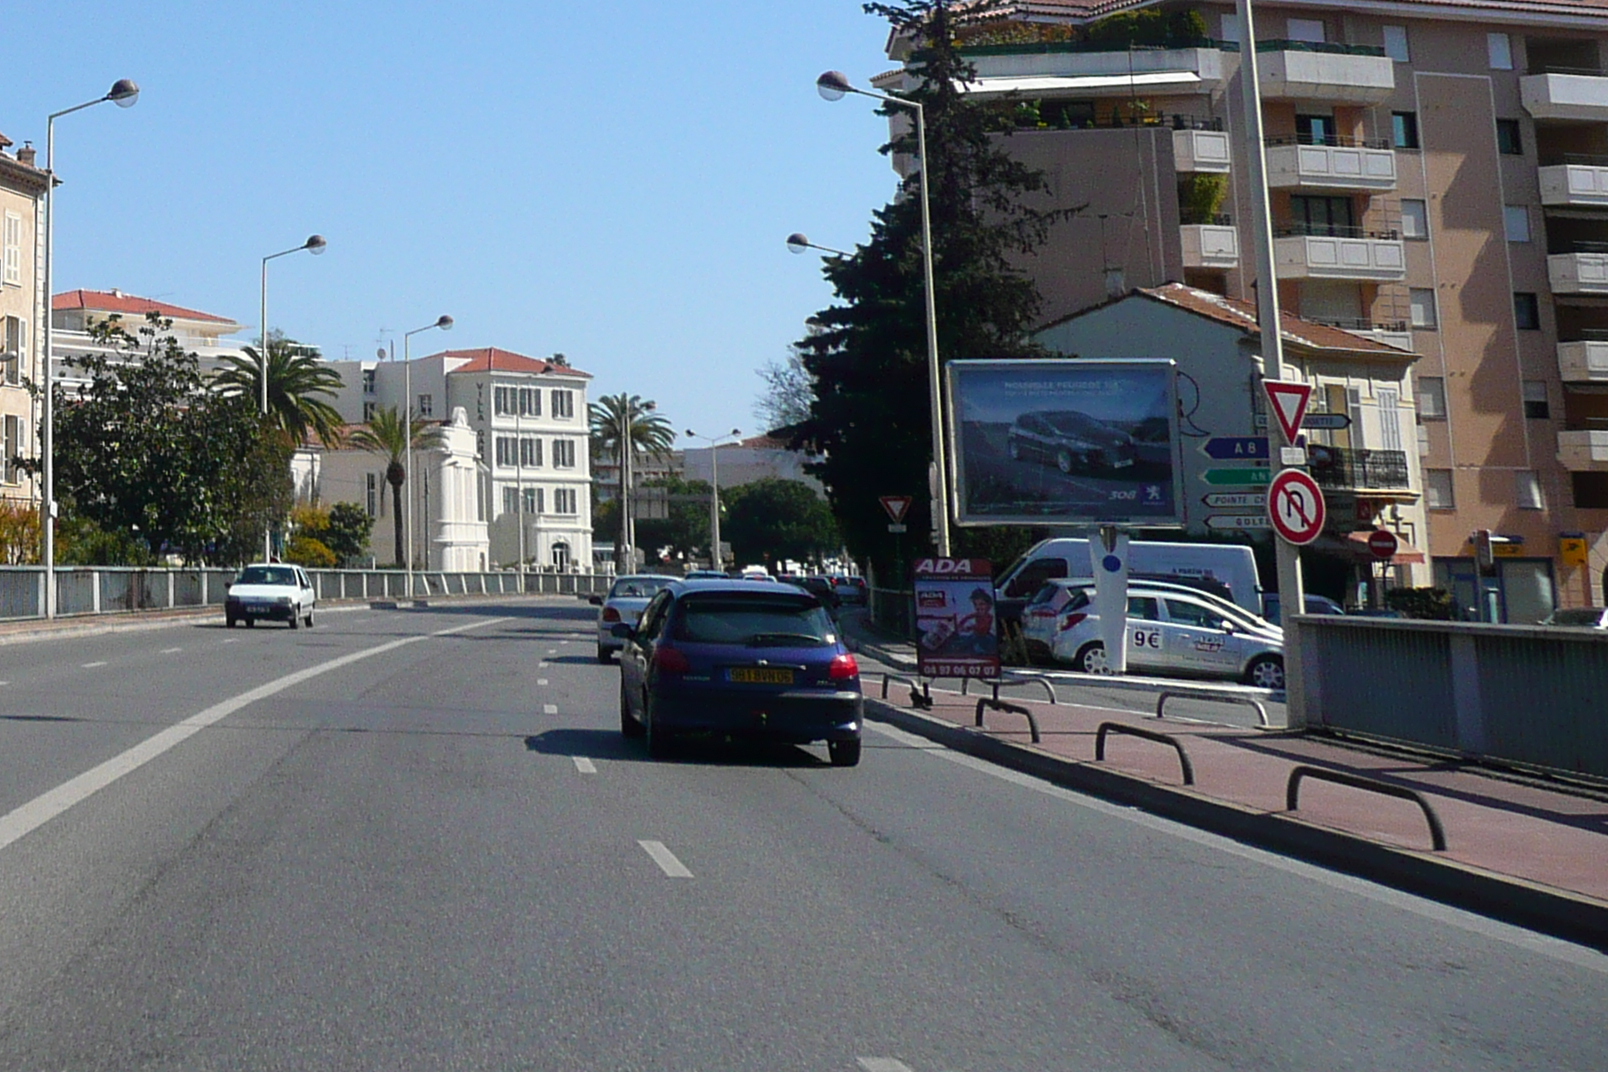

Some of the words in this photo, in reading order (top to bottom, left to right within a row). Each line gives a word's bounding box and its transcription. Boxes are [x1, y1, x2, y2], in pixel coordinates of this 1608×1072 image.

[476, 382, 485, 422] VILLA
[1234, 442, 1243, 454] A
[1247, 442, 1257, 454] 8
[1108, 490, 1137, 500] 308
[1214, 496, 1247, 505] POINTE
[916, 559, 972, 574] ADA
[1134, 631, 1160, 648] 9€
